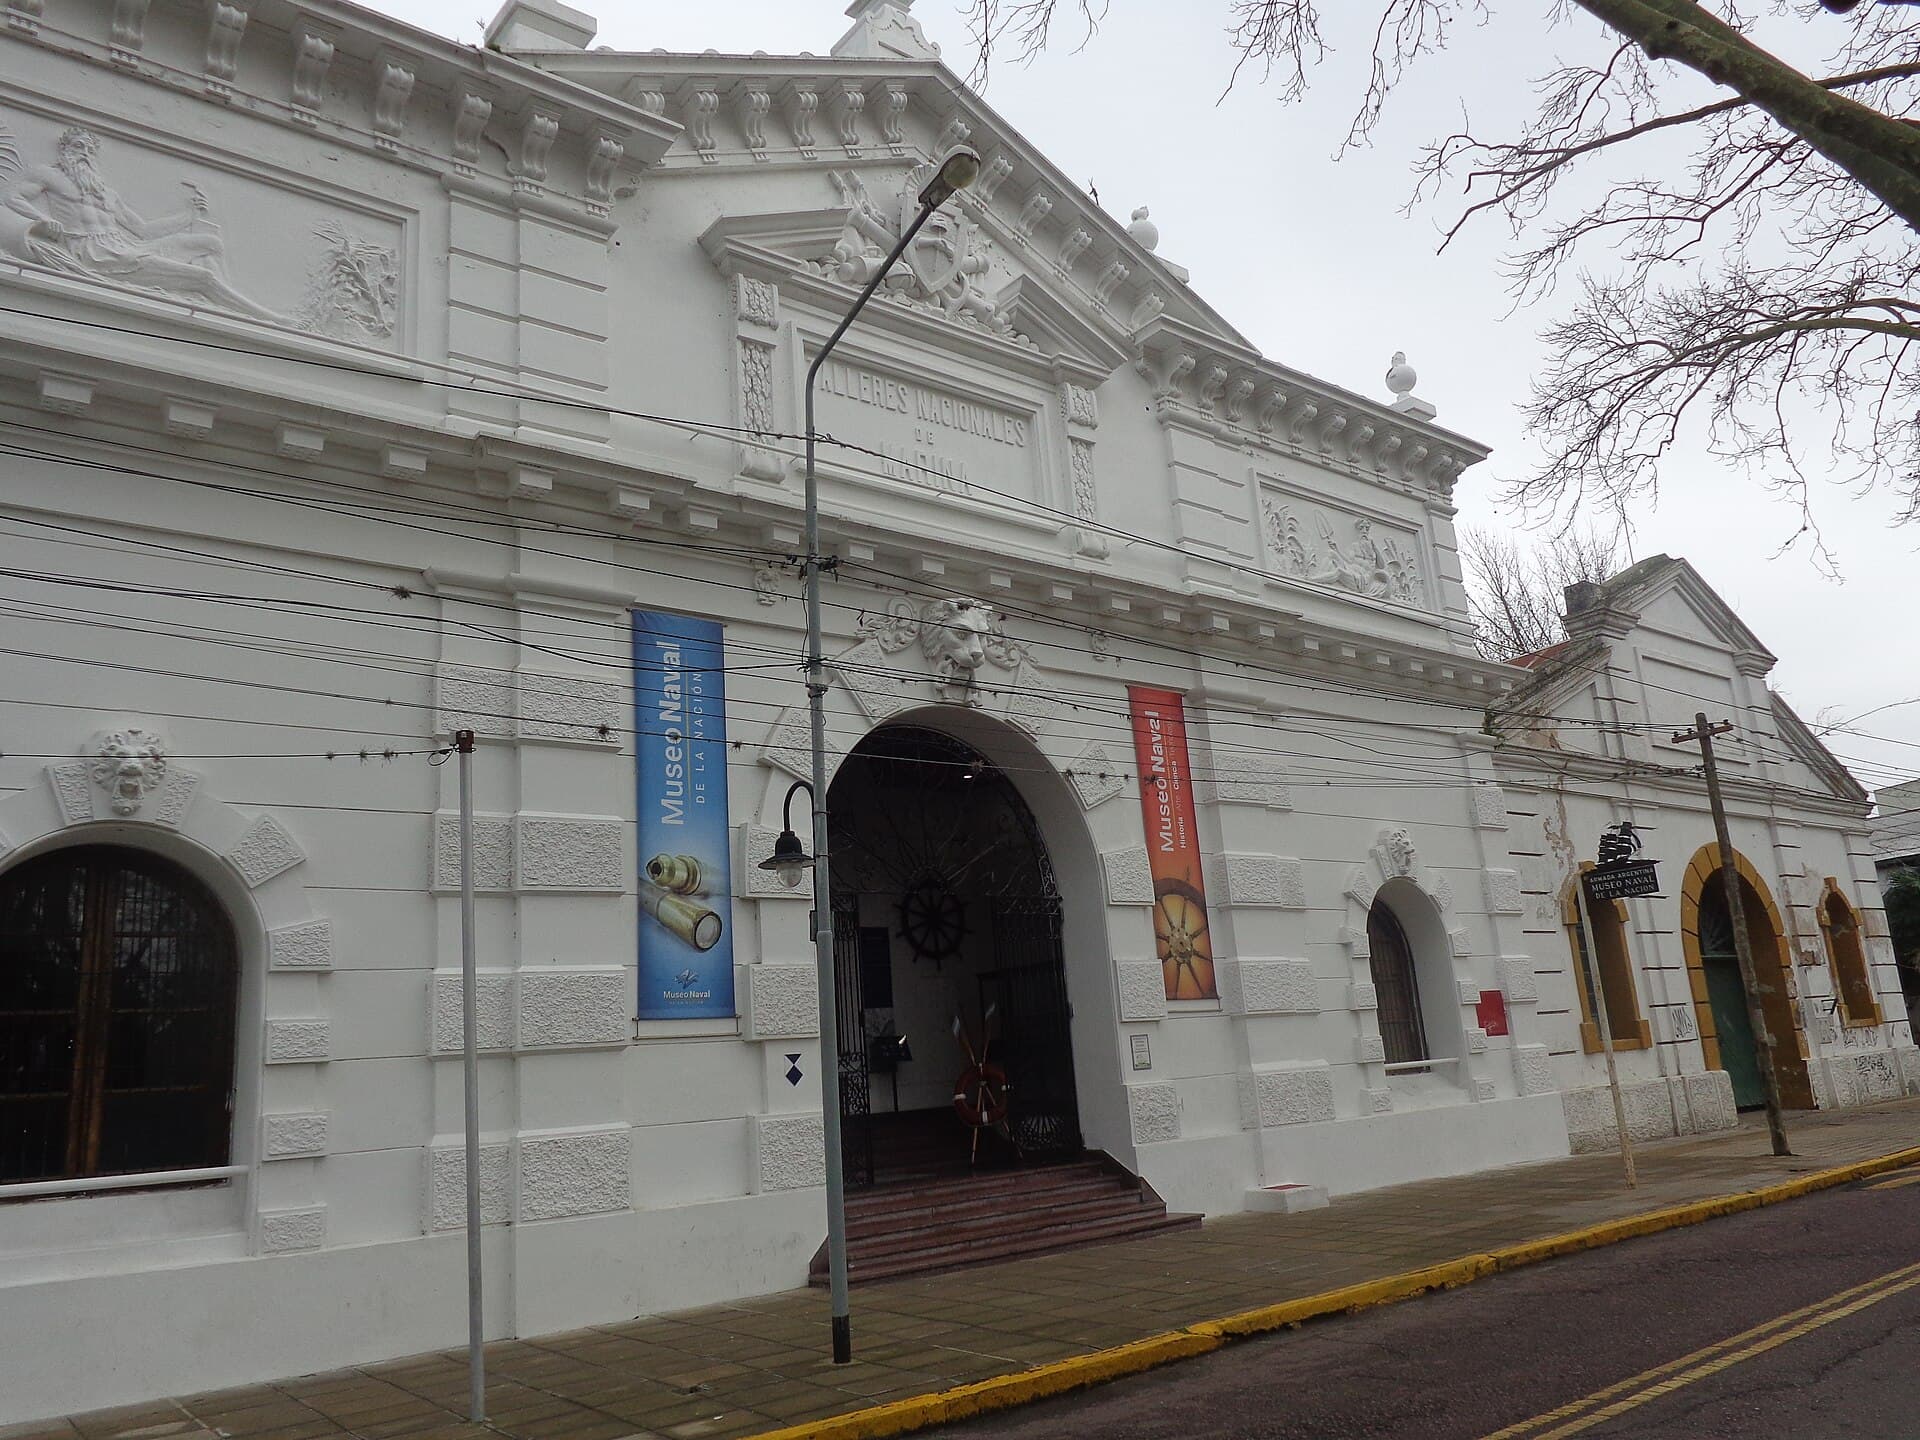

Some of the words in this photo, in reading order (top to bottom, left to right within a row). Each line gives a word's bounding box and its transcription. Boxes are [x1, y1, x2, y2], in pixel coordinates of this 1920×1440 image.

[808, 361, 909, 414] ALLERES
[915, 388, 1025, 448] NACIONALES
[656, 641, 682, 722] Naval
[692, 673, 704, 739] NACIÓN
[695, 751, 705, 771] LA
[1144, 711, 1165, 772] Naval
[661, 727, 684, 825] Museo
[695, 783, 705, 804] DE
[1156, 776, 1174, 852] Museo
[1592, 880, 1622, 891] MUSEO
[1625, 875, 1655, 887] NAVAL
[1595, 891, 1605, 900] DE
[663, 990, 689, 999] Museo
[690, 989, 711, 999] Naval
